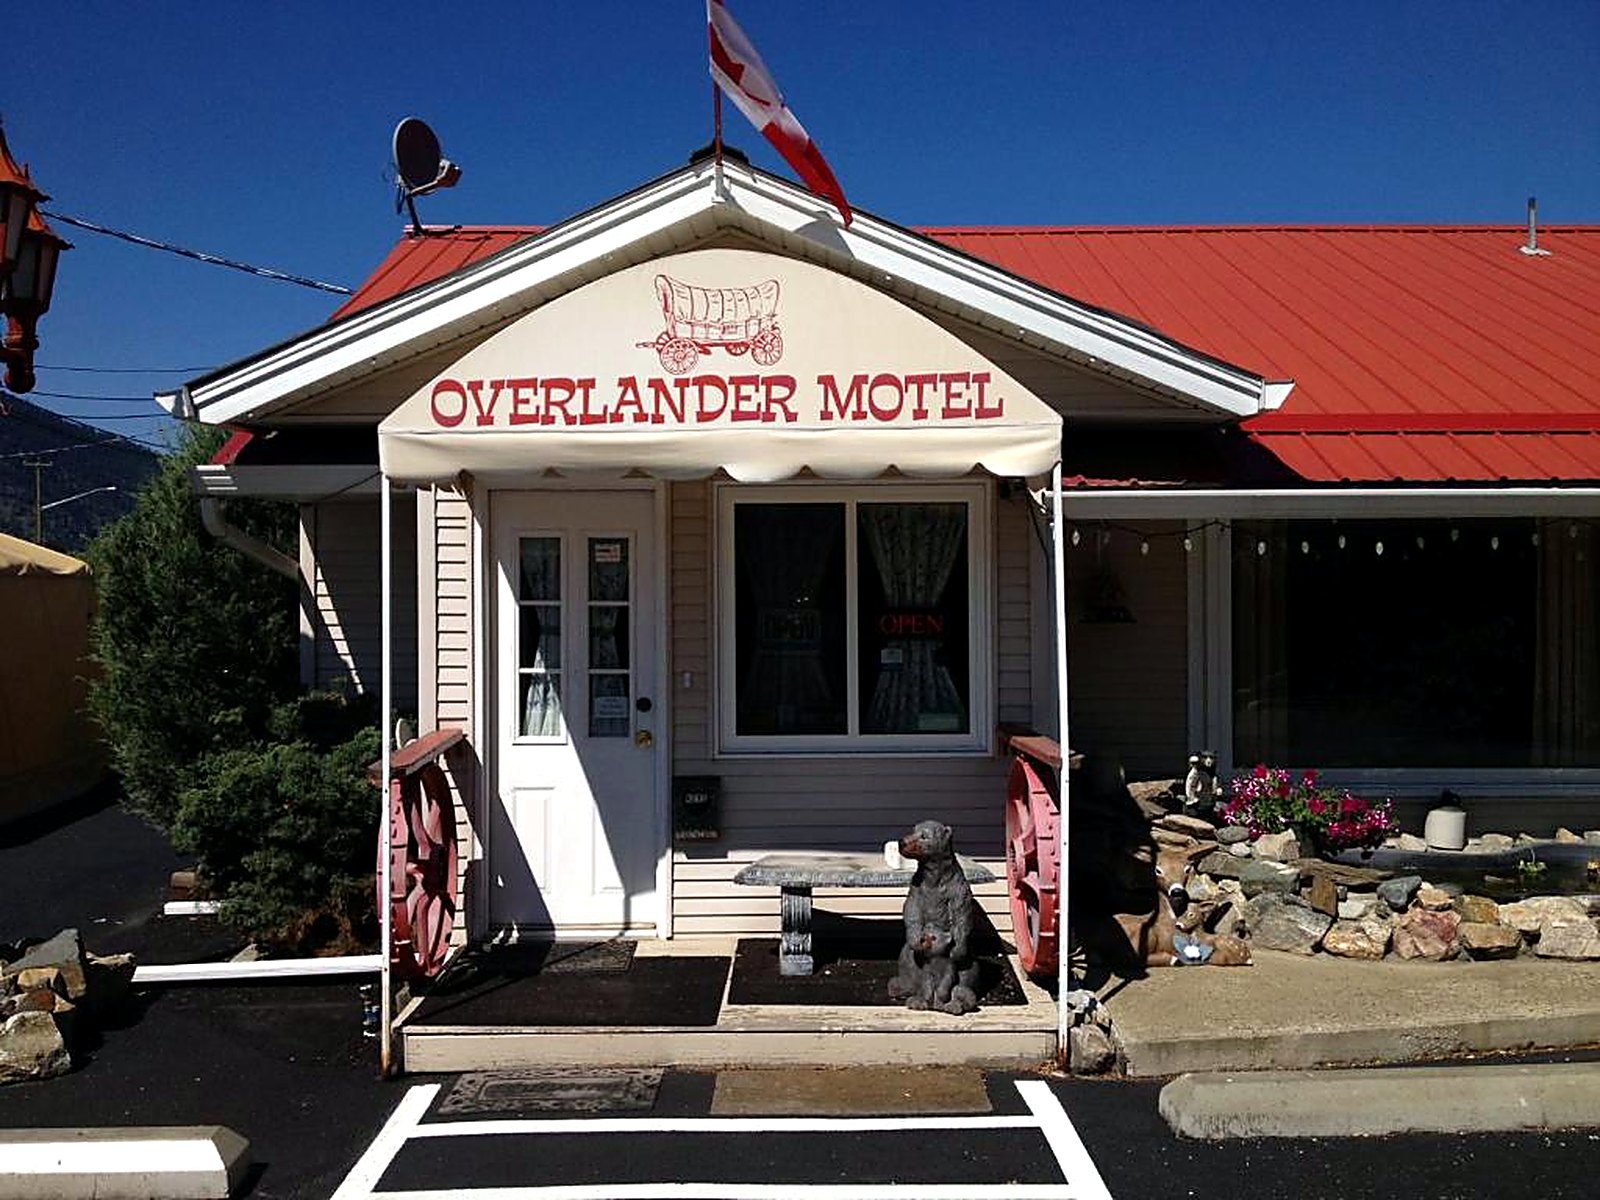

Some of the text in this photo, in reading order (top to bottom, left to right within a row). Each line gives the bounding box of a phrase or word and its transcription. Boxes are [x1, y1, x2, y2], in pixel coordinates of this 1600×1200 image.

[431, 372, 1003, 426] OVERLANDER MOTEL
[879, 613, 944, 634] OPEN
